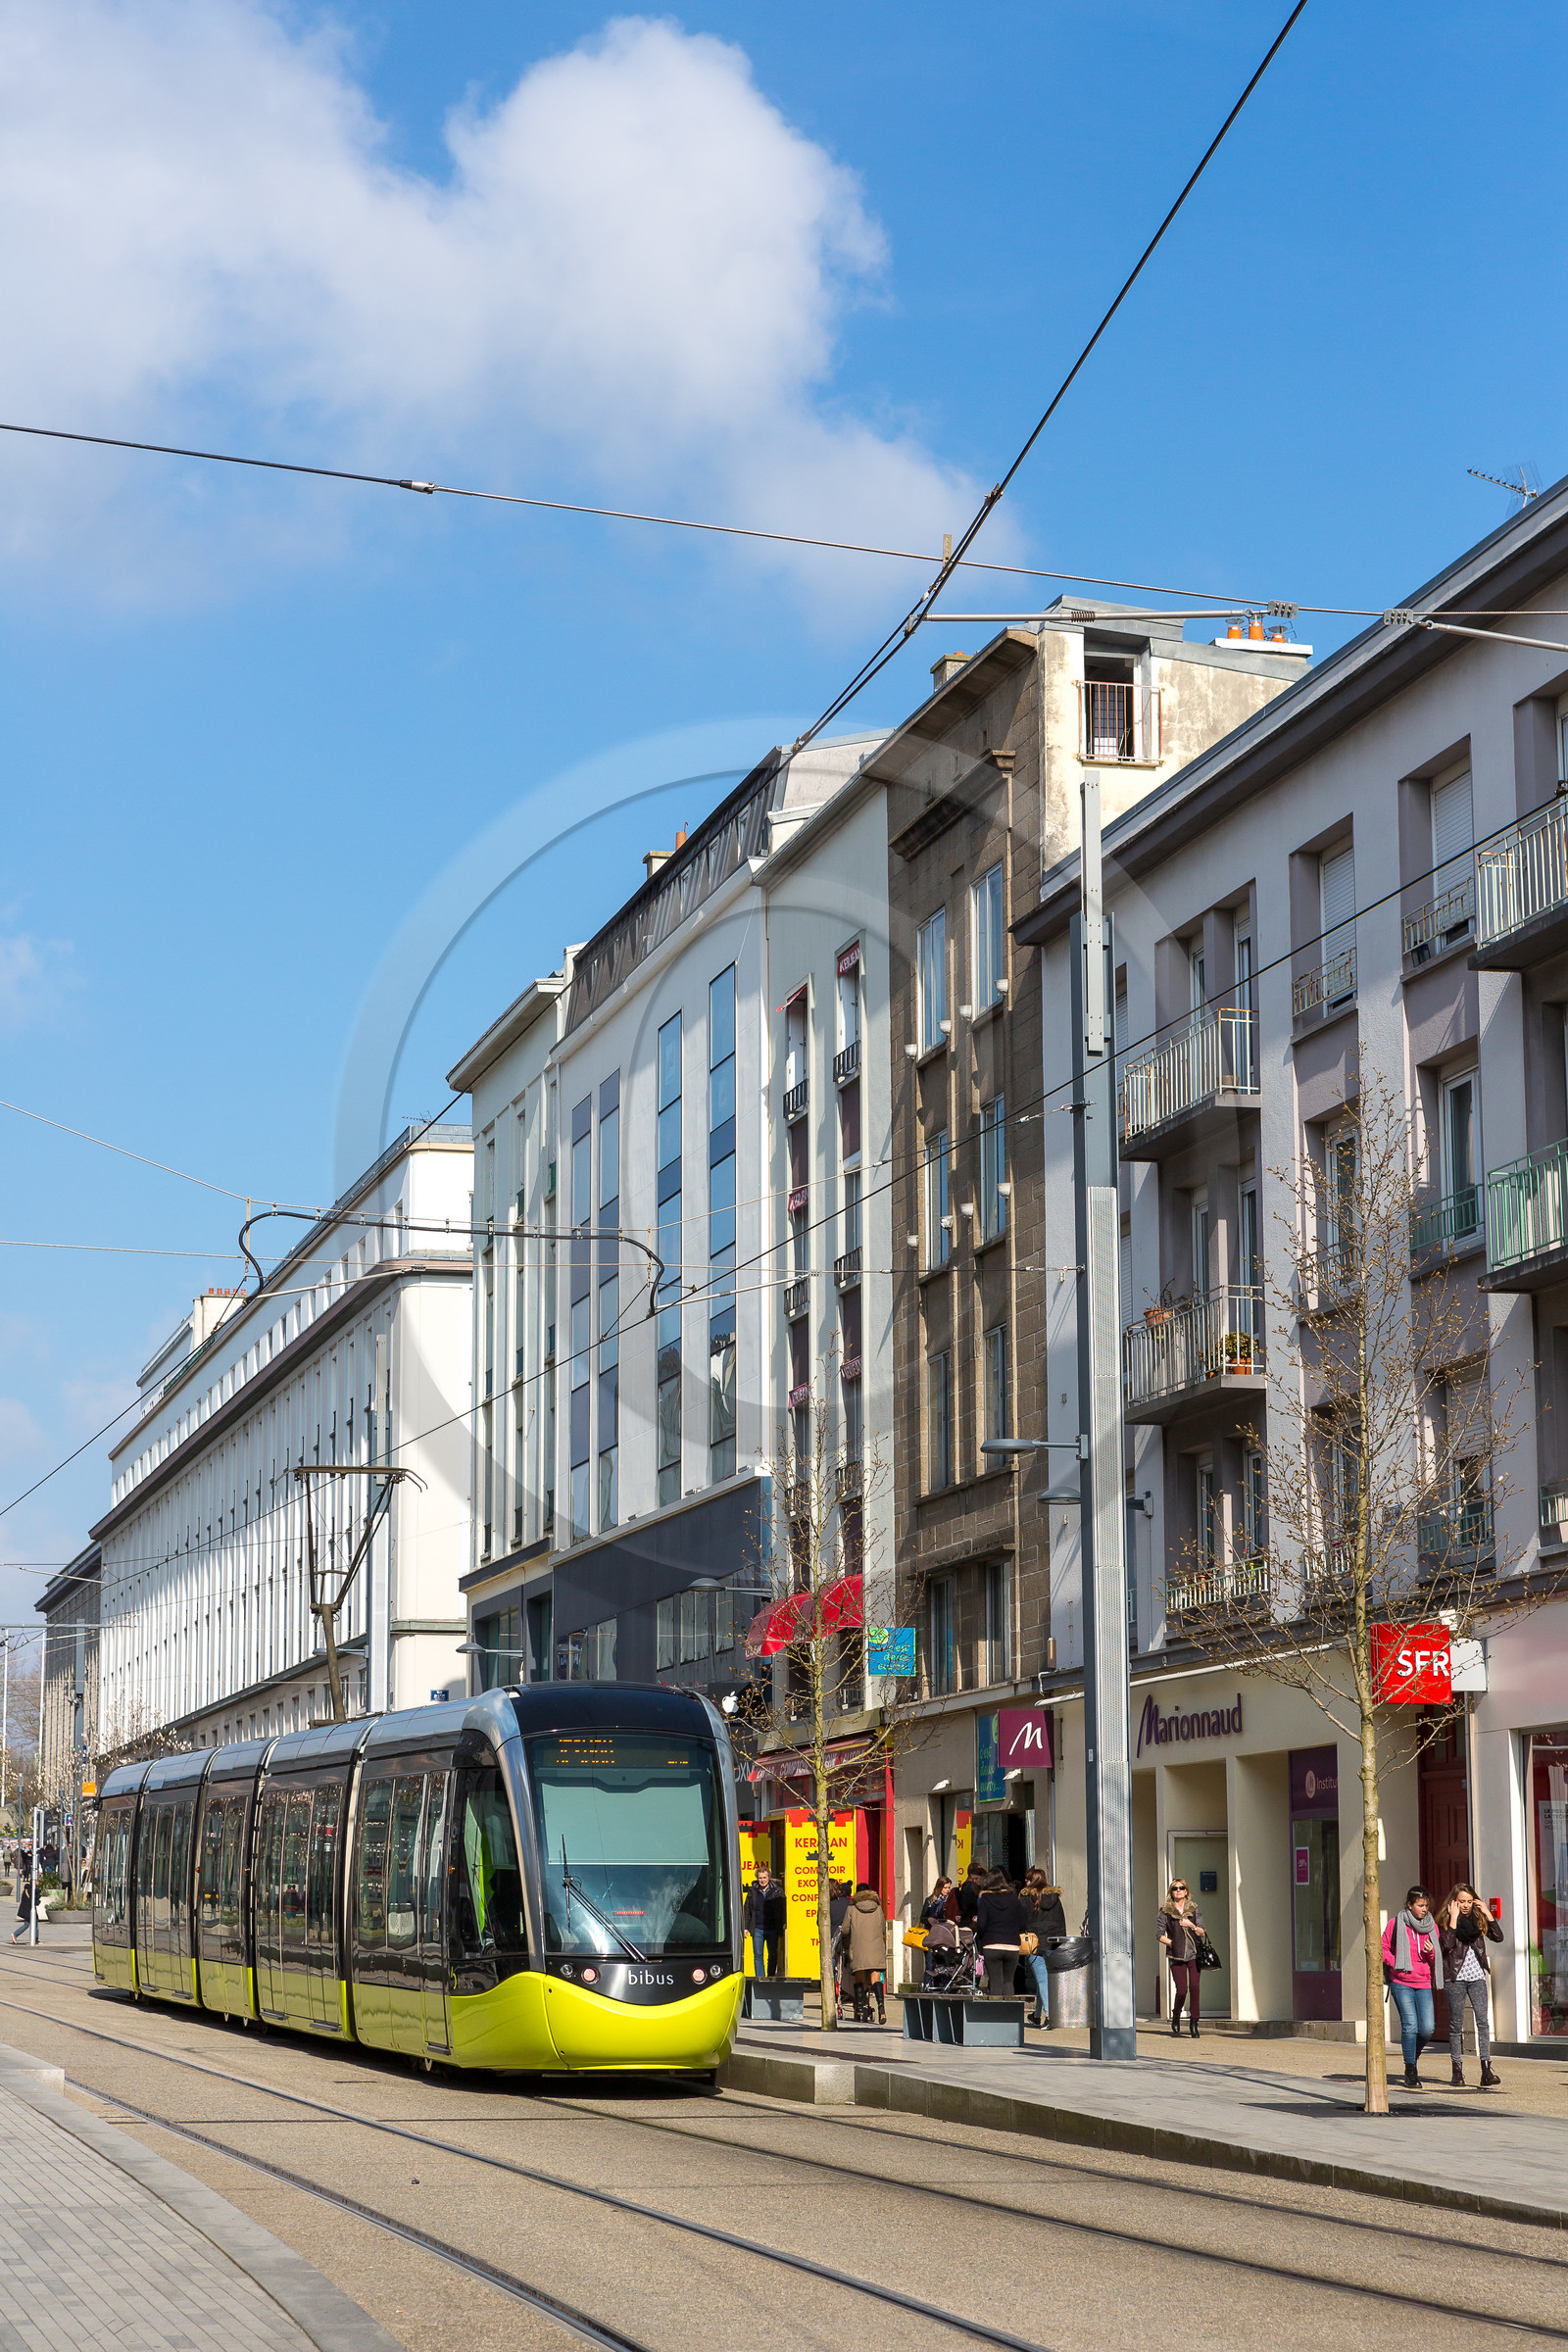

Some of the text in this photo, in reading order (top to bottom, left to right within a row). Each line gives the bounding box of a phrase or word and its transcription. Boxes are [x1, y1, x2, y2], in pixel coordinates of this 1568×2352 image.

[1396, 1649, 1450, 1677] SFR
[1136, 1692, 1243, 1759] Marionnaud
[795, 1838, 848, 1848] KERAN
[627, 1970, 674, 1985] bibus
